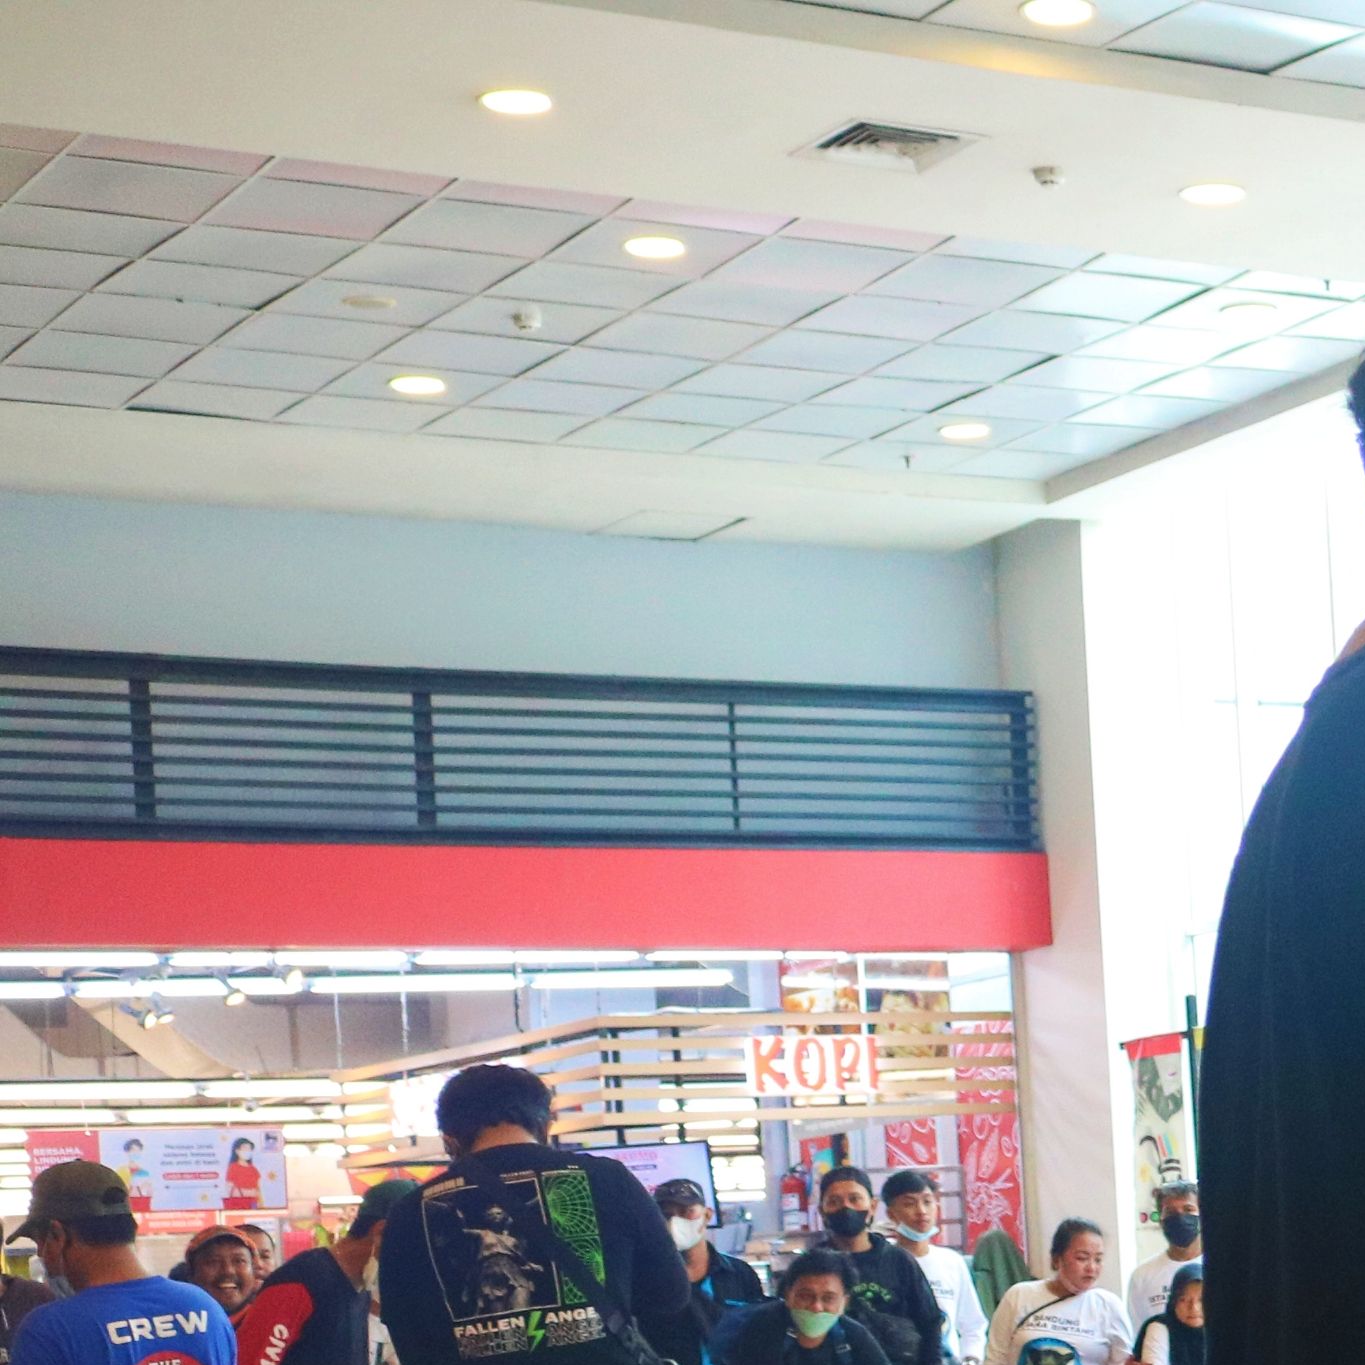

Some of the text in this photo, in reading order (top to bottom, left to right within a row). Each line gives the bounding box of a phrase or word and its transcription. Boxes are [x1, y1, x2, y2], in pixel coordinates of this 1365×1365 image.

[751, 1035, 880, 1093] KOPI
[106, 1310, 208, 1345] CREW
[454, 1316, 525, 1338] FALLEN
[545, 1307, 598, 1324] ANGE
